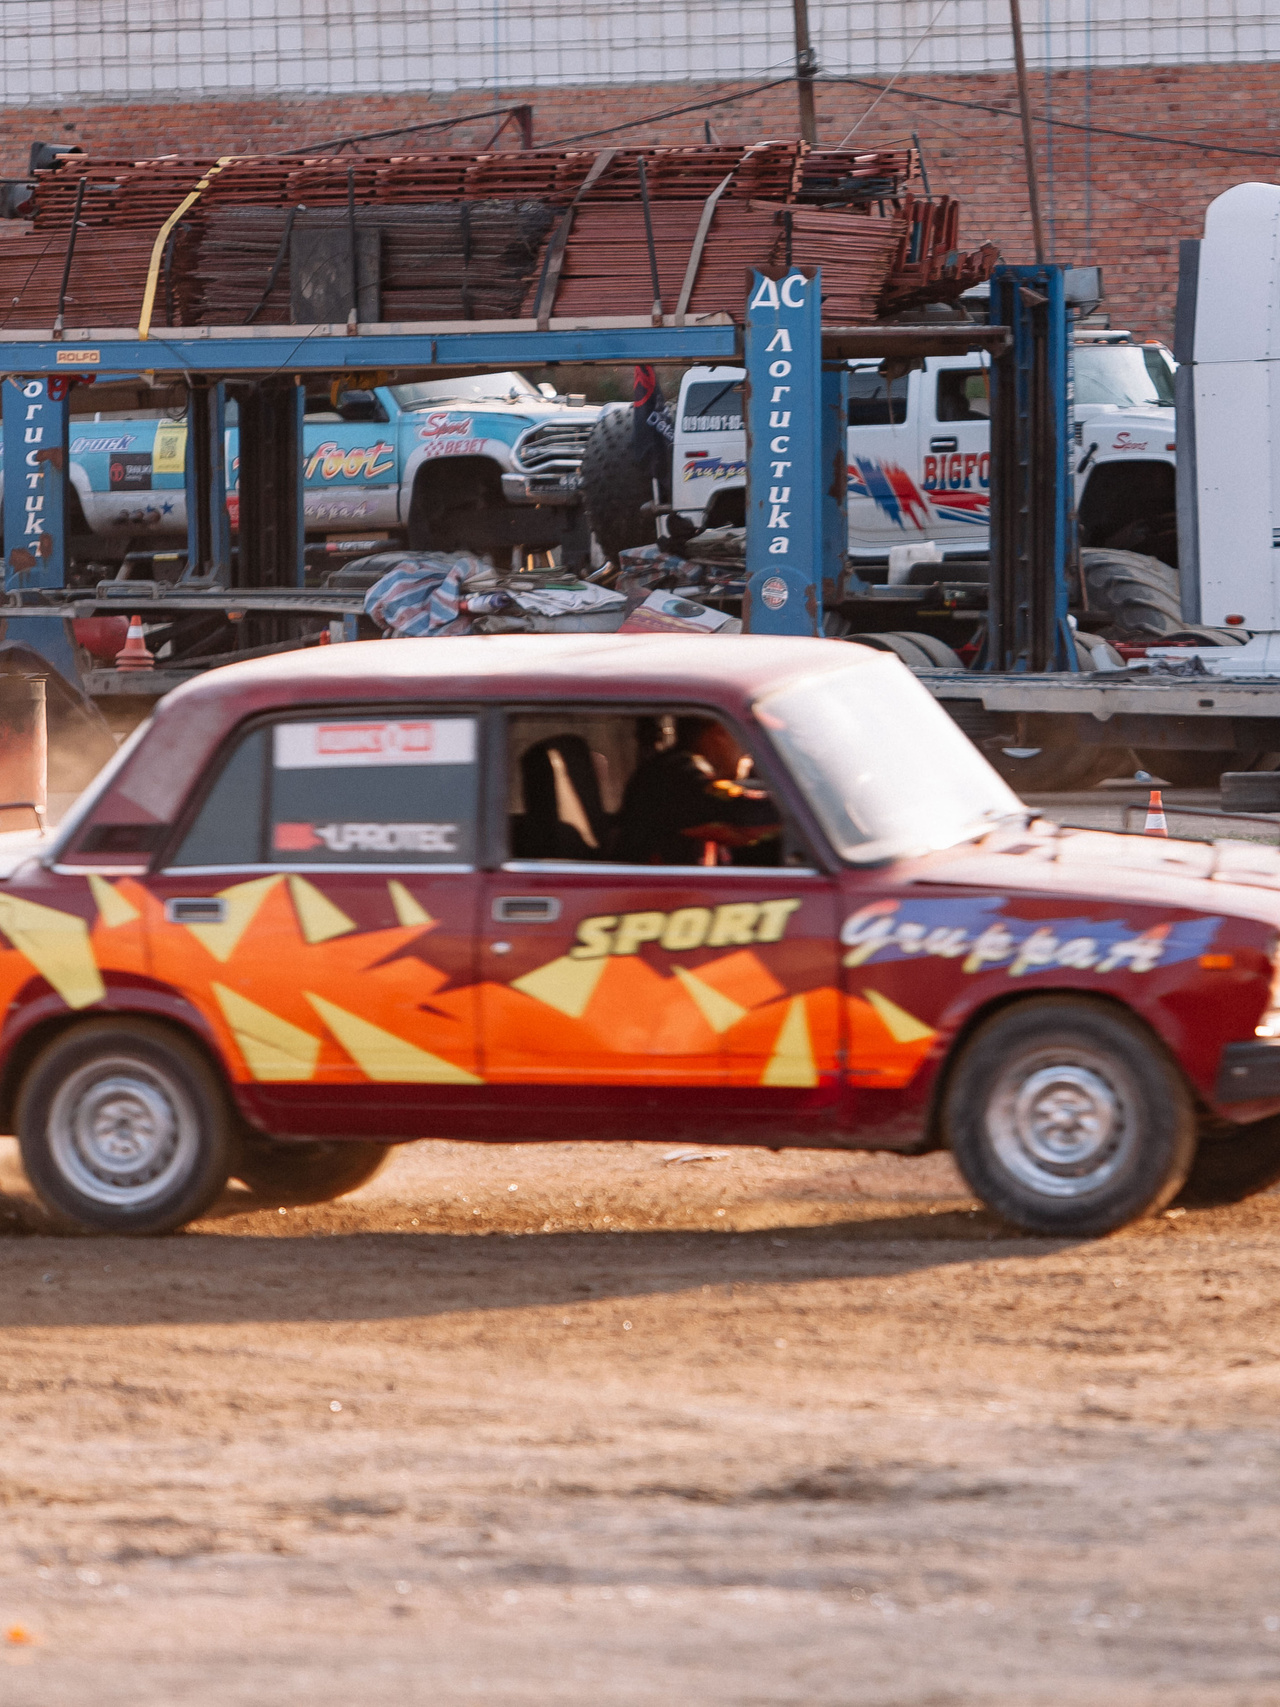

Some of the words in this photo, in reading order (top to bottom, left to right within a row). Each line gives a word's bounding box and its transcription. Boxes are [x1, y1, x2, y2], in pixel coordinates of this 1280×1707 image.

[751, 274, 809, 310] ДС
[57, 352, 99, 362] ROLFO
[569, 897, 802, 961] SPORT
